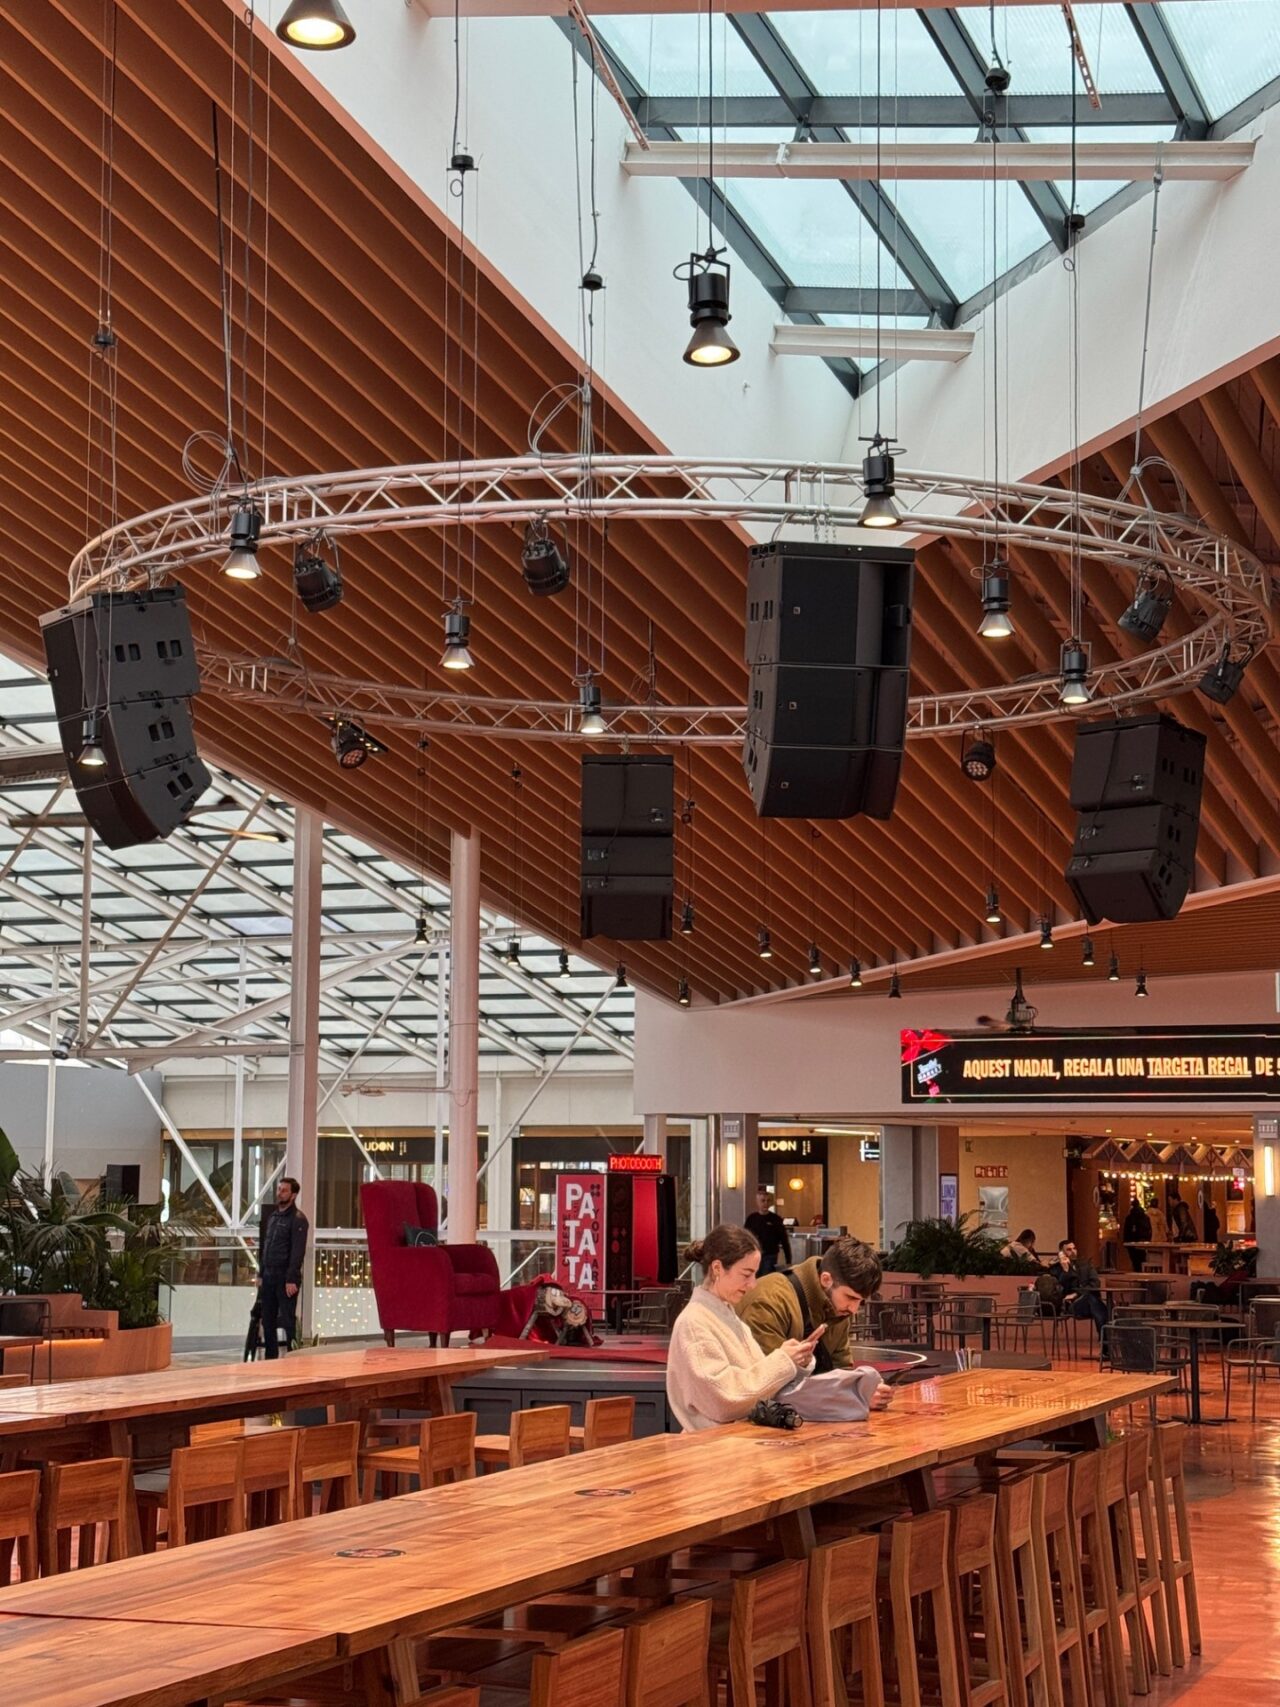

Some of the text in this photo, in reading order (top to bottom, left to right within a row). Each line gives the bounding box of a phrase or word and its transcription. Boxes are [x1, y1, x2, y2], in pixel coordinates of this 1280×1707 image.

[963, 1059, 1011, 1080] AQUEST
[1014, 1059, 1060, 1080] NADAL,
[1063, 1058, 1114, 1077] REGALA
[1116, 1058, 1145, 1076] UNA
[1147, 1057, 1204, 1077] TARGETA
[1208, 1057, 1251, 1076] REGAL
[1255, 1056, 1274, 1076] DE
[364, 1141, 394, 1151] UDON
[761, 1140, 796, 1151] UDON
[609, 1156, 662, 1170] PHOTOBOOTH
